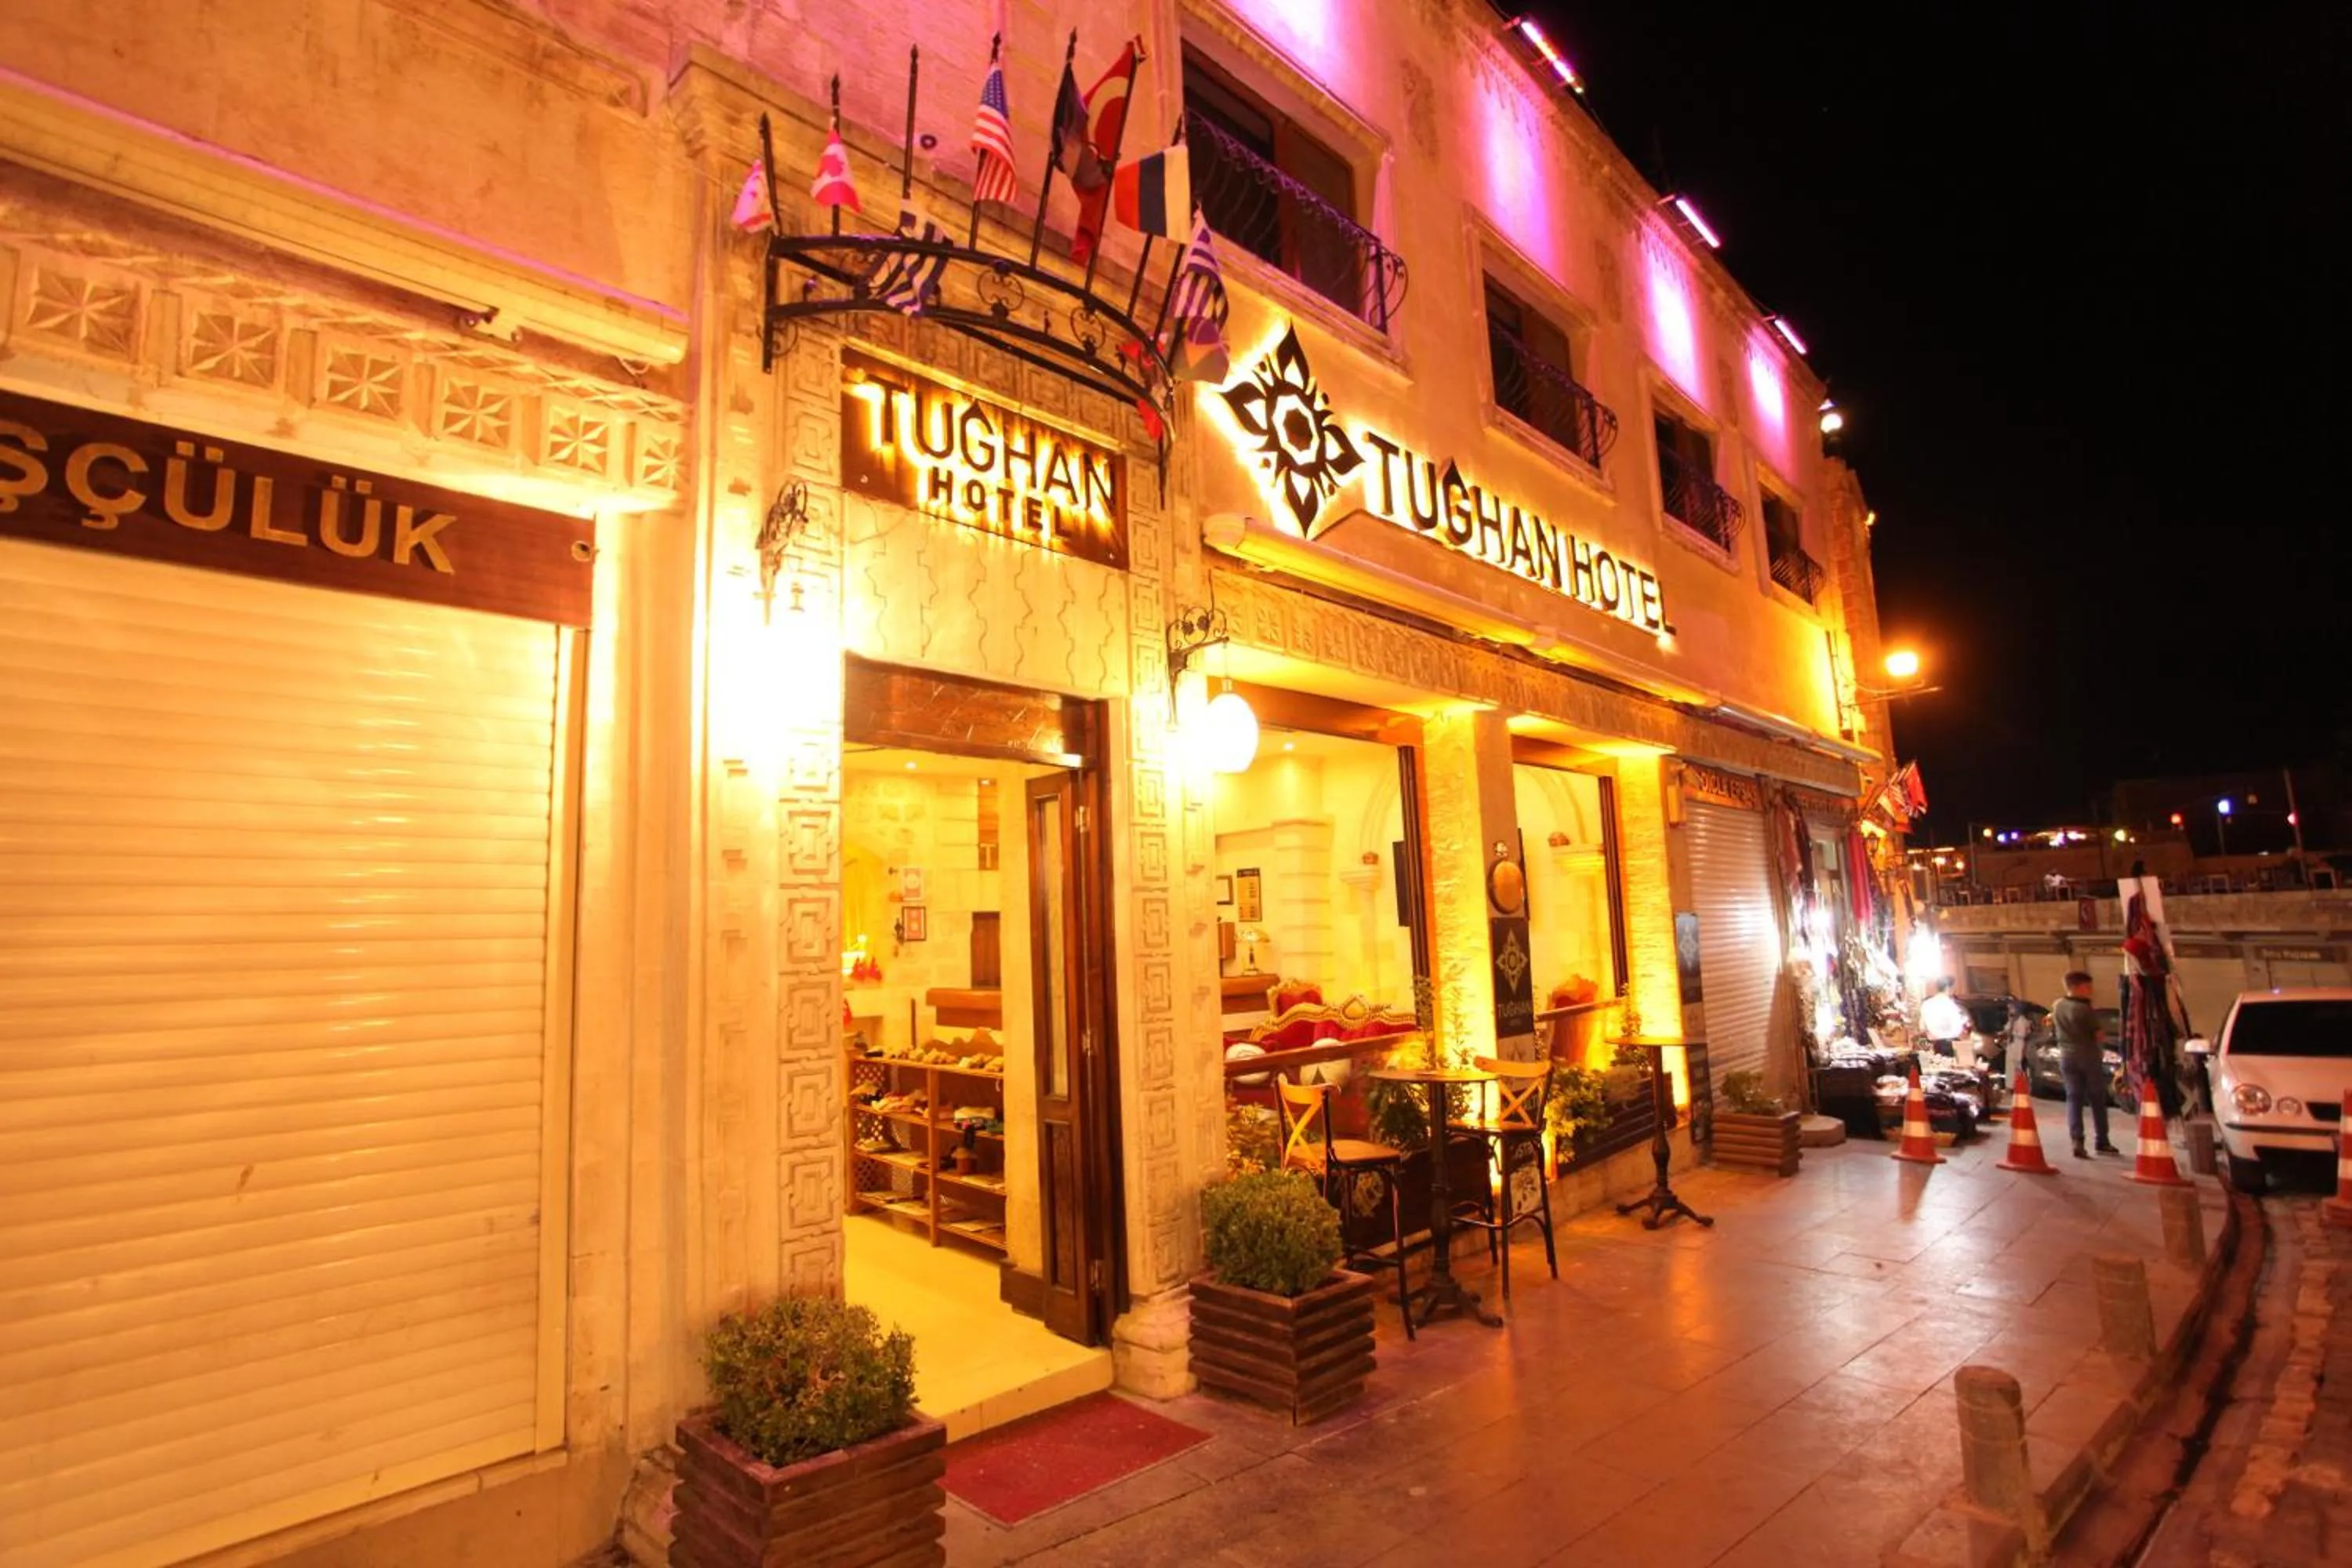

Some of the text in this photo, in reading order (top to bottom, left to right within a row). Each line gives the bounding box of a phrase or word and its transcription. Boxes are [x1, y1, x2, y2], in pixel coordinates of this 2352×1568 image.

[866, 372, 1117, 512] TUGHAN
[931, 466, 1071, 537] HOTEL
[1366, 430, 1676, 636] TUGHAN HOTEL
